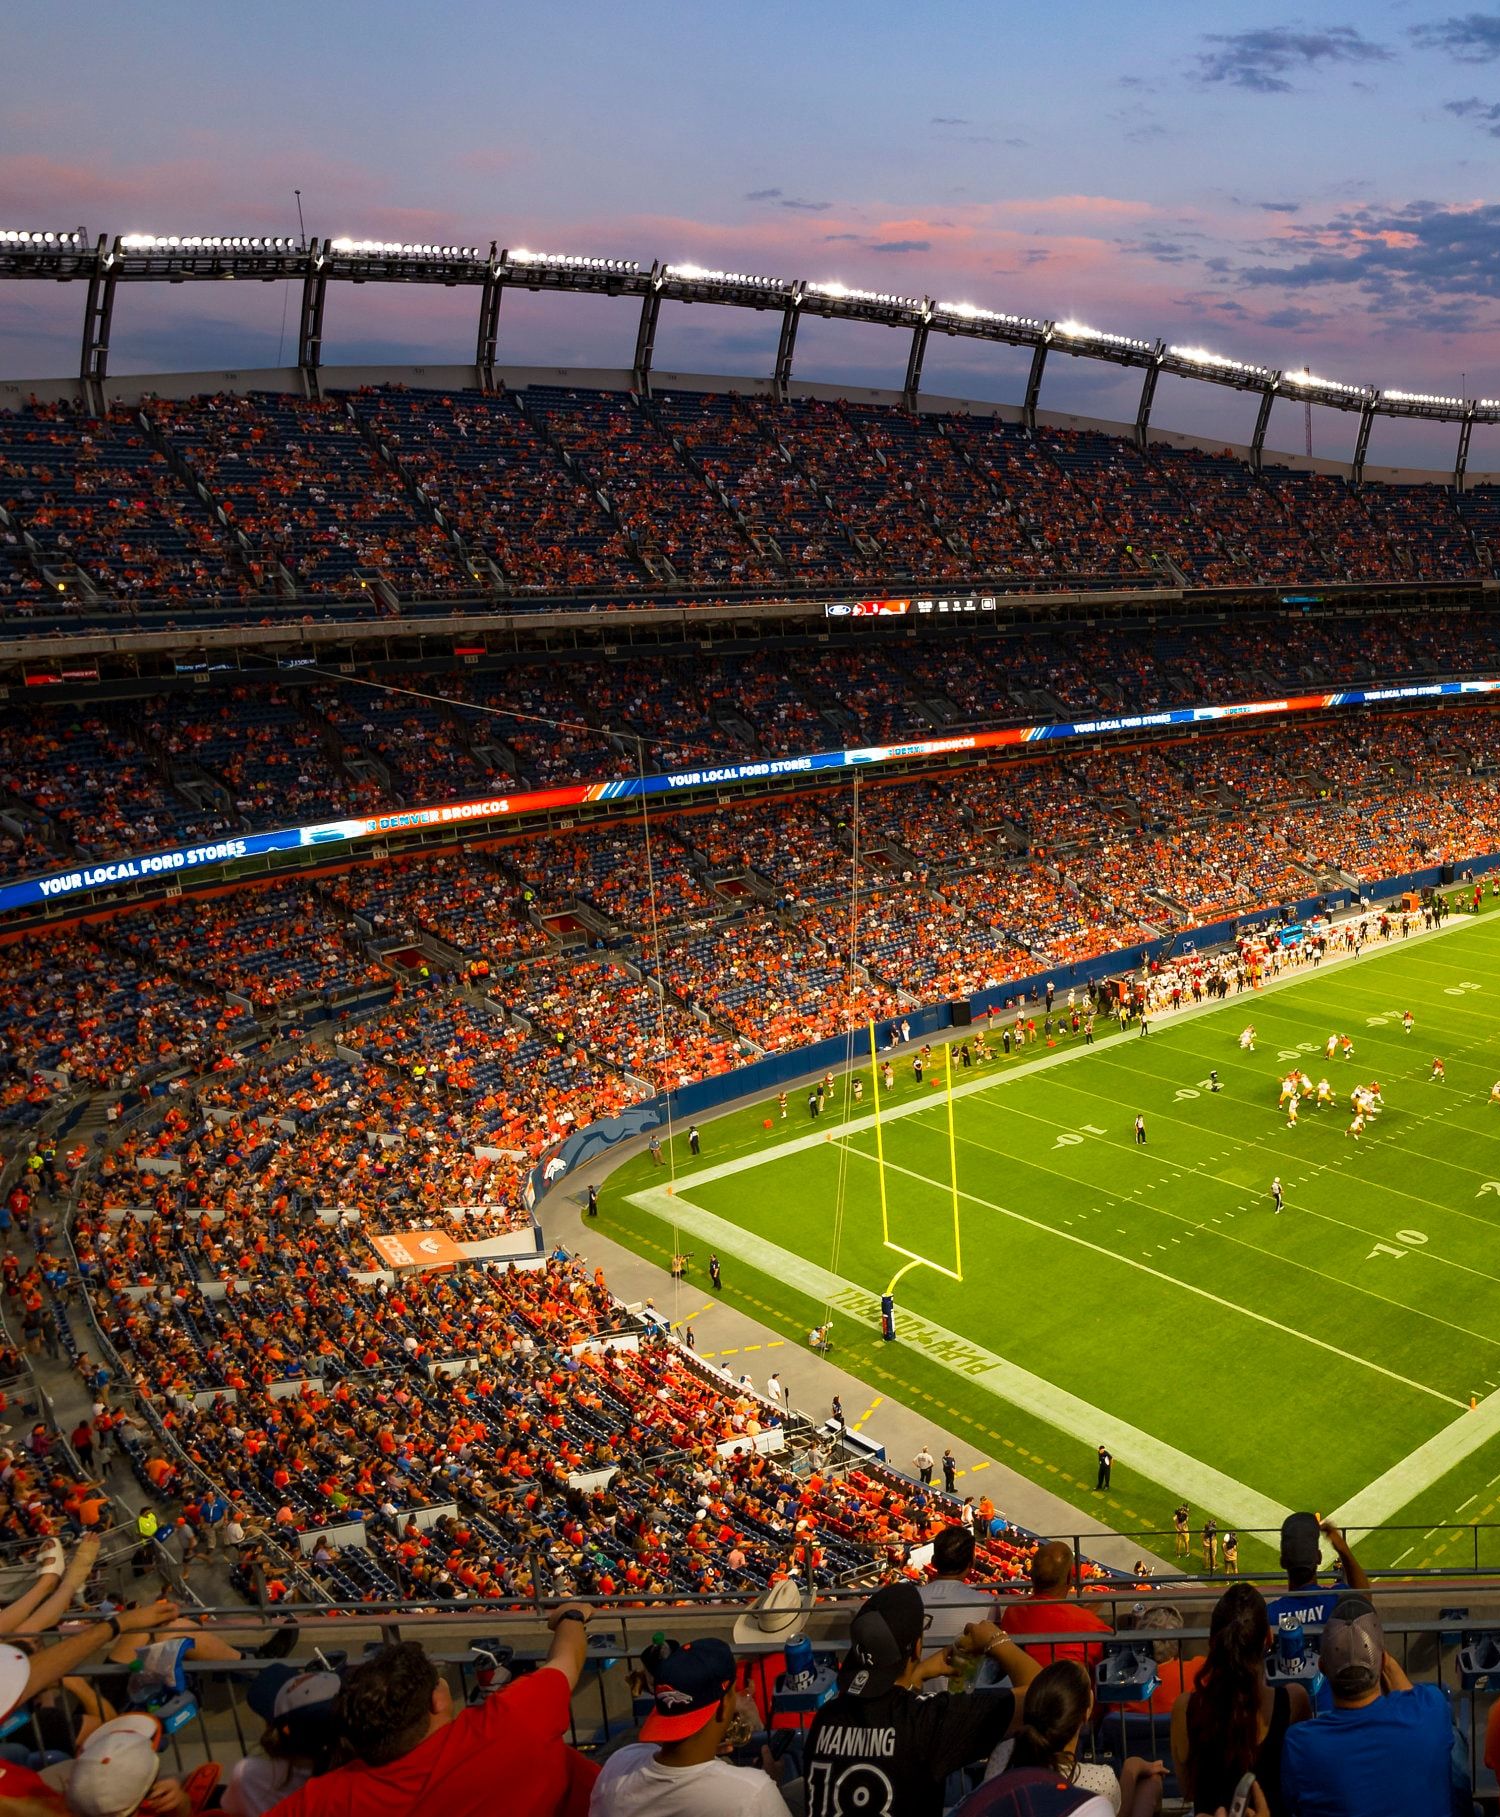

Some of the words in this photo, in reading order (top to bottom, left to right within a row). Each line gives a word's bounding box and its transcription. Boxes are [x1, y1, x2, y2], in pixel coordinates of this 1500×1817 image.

[1073, 722, 1095, 734] YOUR
[1096, 719, 1121, 731] LOCAL
[1121, 716, 1142, 728] FORD
[1143, 713, 1171, 725] STORES
[667, 773, 700, 787] YOUR
[702, 767, 738, 782] LOCAL
[740, 763, 769, 778] FORD
[770, 757, 812, 775] STORES
[380, 811, 439, 830] DENVER
[442, 800, 509, 821] BRONCOS
[39, 873, 82, 896] YOUR
[85, 862, 139, 885] LOCAL
[141, 852, 184, 873] FORD
[187, 840, 247, 865] STORES
[1443, 981, 1482, 995] 50
[1278, 1042, 1322, 1061] 30
[1056, 1124, 1108, 1146] 10
[1373, 1229, 1429, 1259] 10
[923, 1340, 1003, 1376] PLAY
[815, 1725, 896, 1757] MANNING
[807, 1761, 894, 1817] 18
